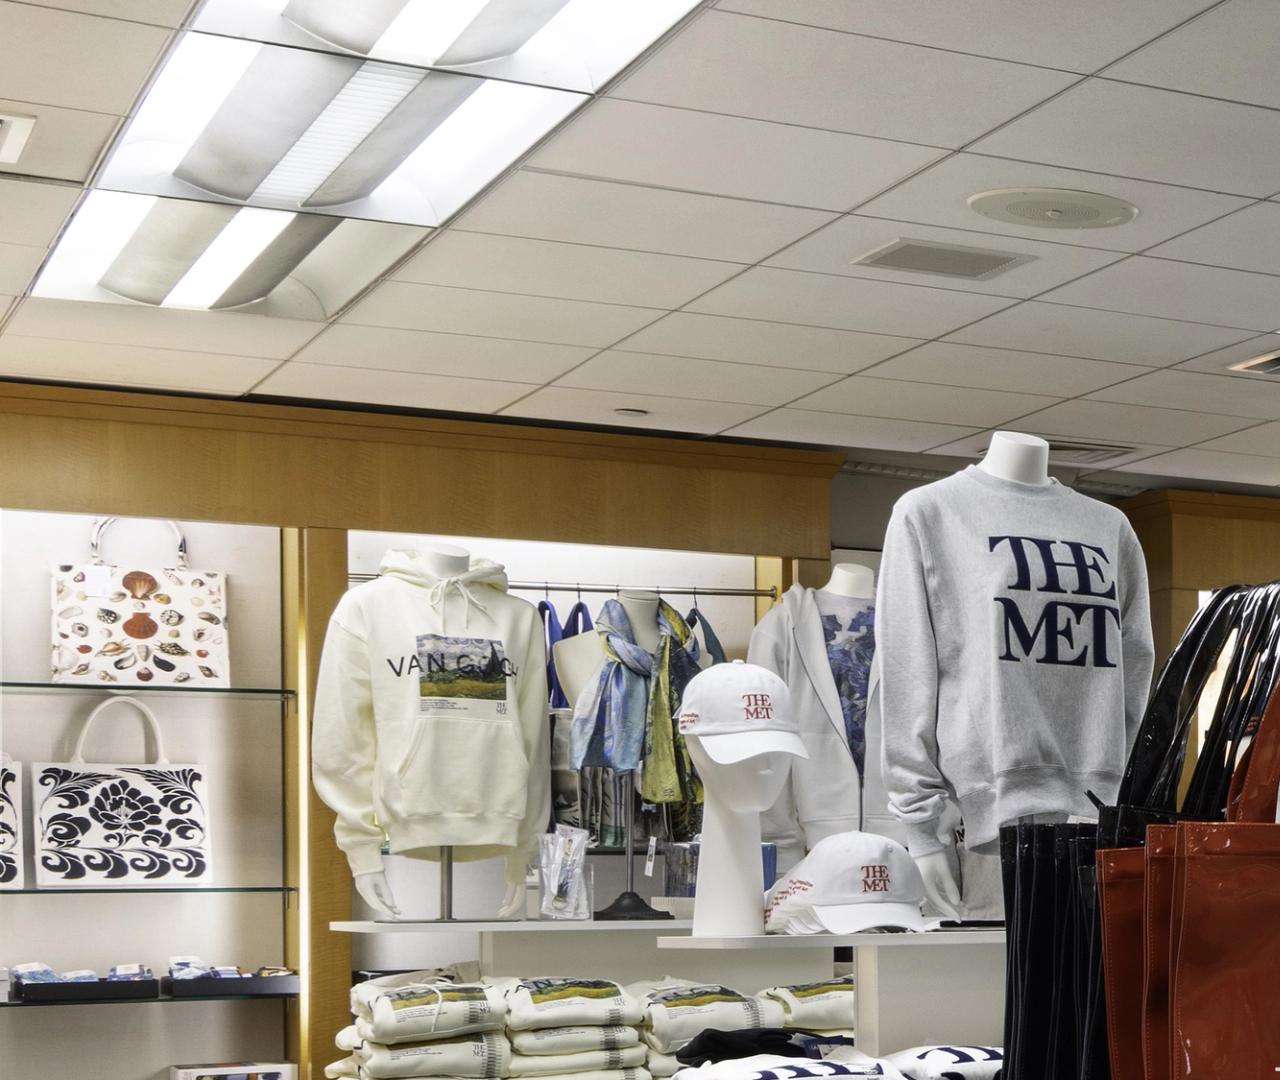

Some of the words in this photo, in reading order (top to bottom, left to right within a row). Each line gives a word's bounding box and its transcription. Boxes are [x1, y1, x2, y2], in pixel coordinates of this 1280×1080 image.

[988, 535, 1117, 598] THE
[994, 597, 1119, 668] MET
[387, 653, 447, 677] VAN
[743, 694, 771, 707] THE
[744, 707, 773, 720] MET
[861, 865, 889, 878] THE
[862, 879, 890, 893] MET
